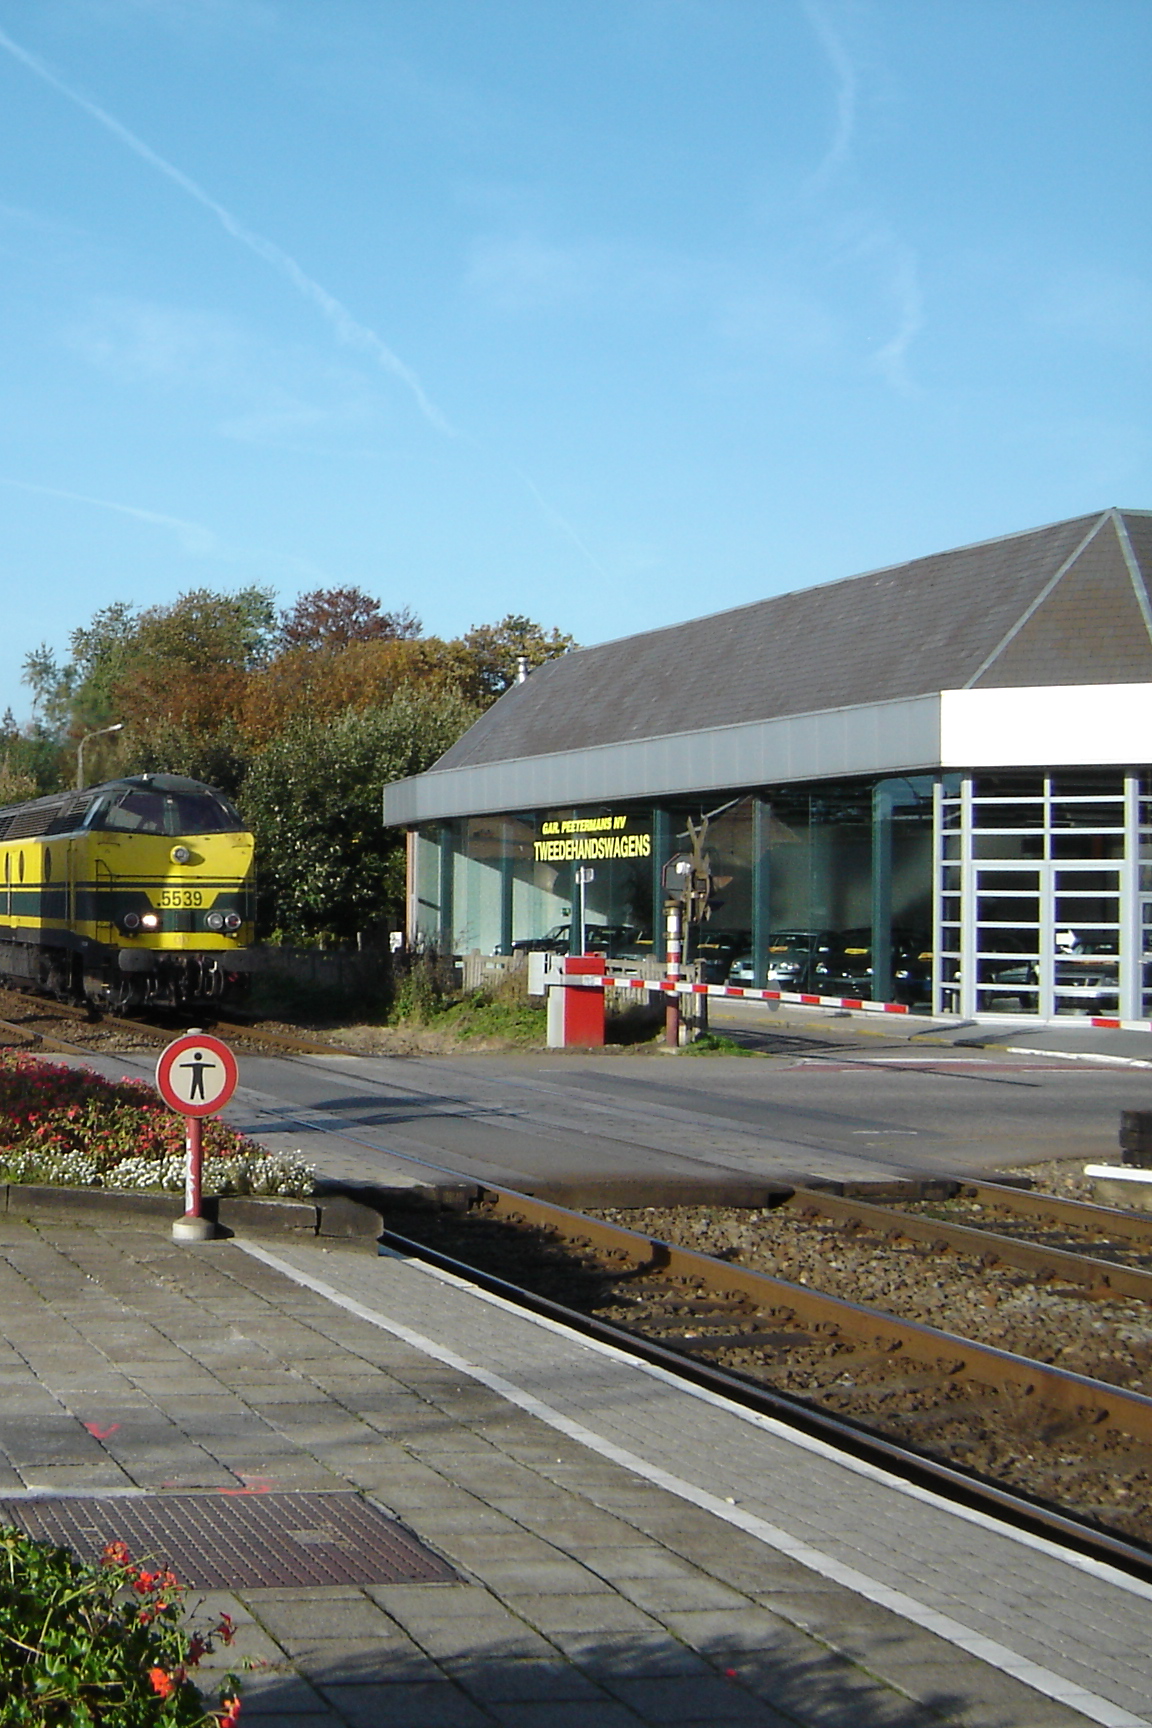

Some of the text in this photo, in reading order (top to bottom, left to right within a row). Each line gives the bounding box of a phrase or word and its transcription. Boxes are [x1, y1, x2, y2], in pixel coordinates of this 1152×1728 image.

[542, 815, 627, 835] GAR. PEETERMANS NV
[533, 834, 651, 861] TWEEDEHANDSWAGENS
